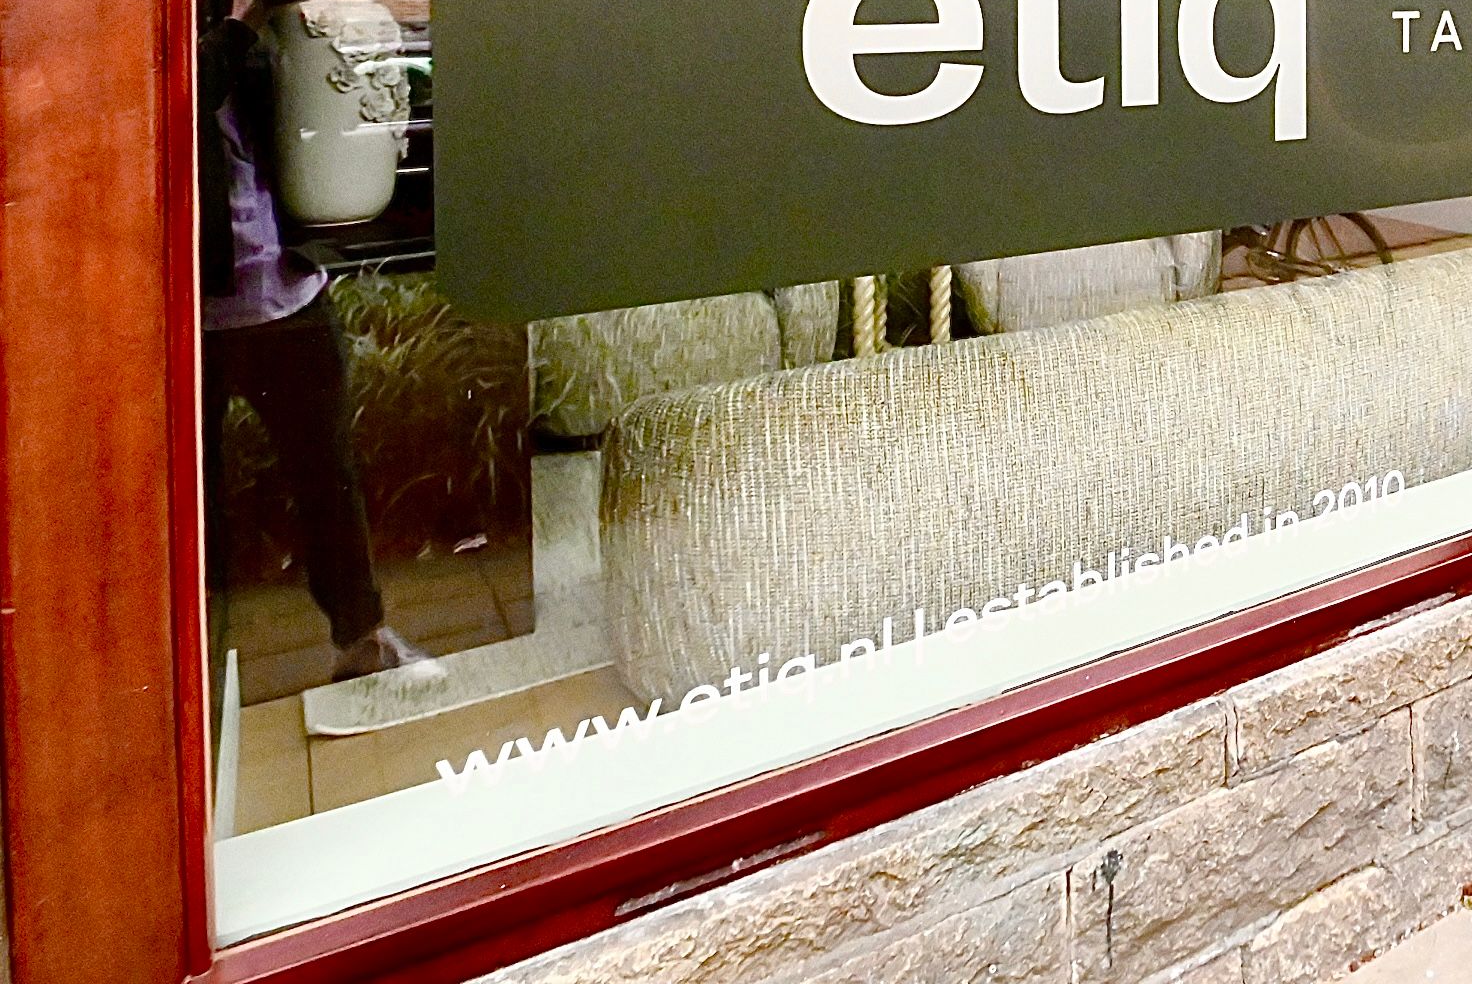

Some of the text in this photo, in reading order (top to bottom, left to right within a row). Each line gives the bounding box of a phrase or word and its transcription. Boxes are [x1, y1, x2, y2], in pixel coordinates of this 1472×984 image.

[435, 616, 892, 799] www.etiq.nl
[944, 512, 1250, 643] established
[1263, 507, 1300, 547] in
[1313, 469, 1406, 527] 2010
